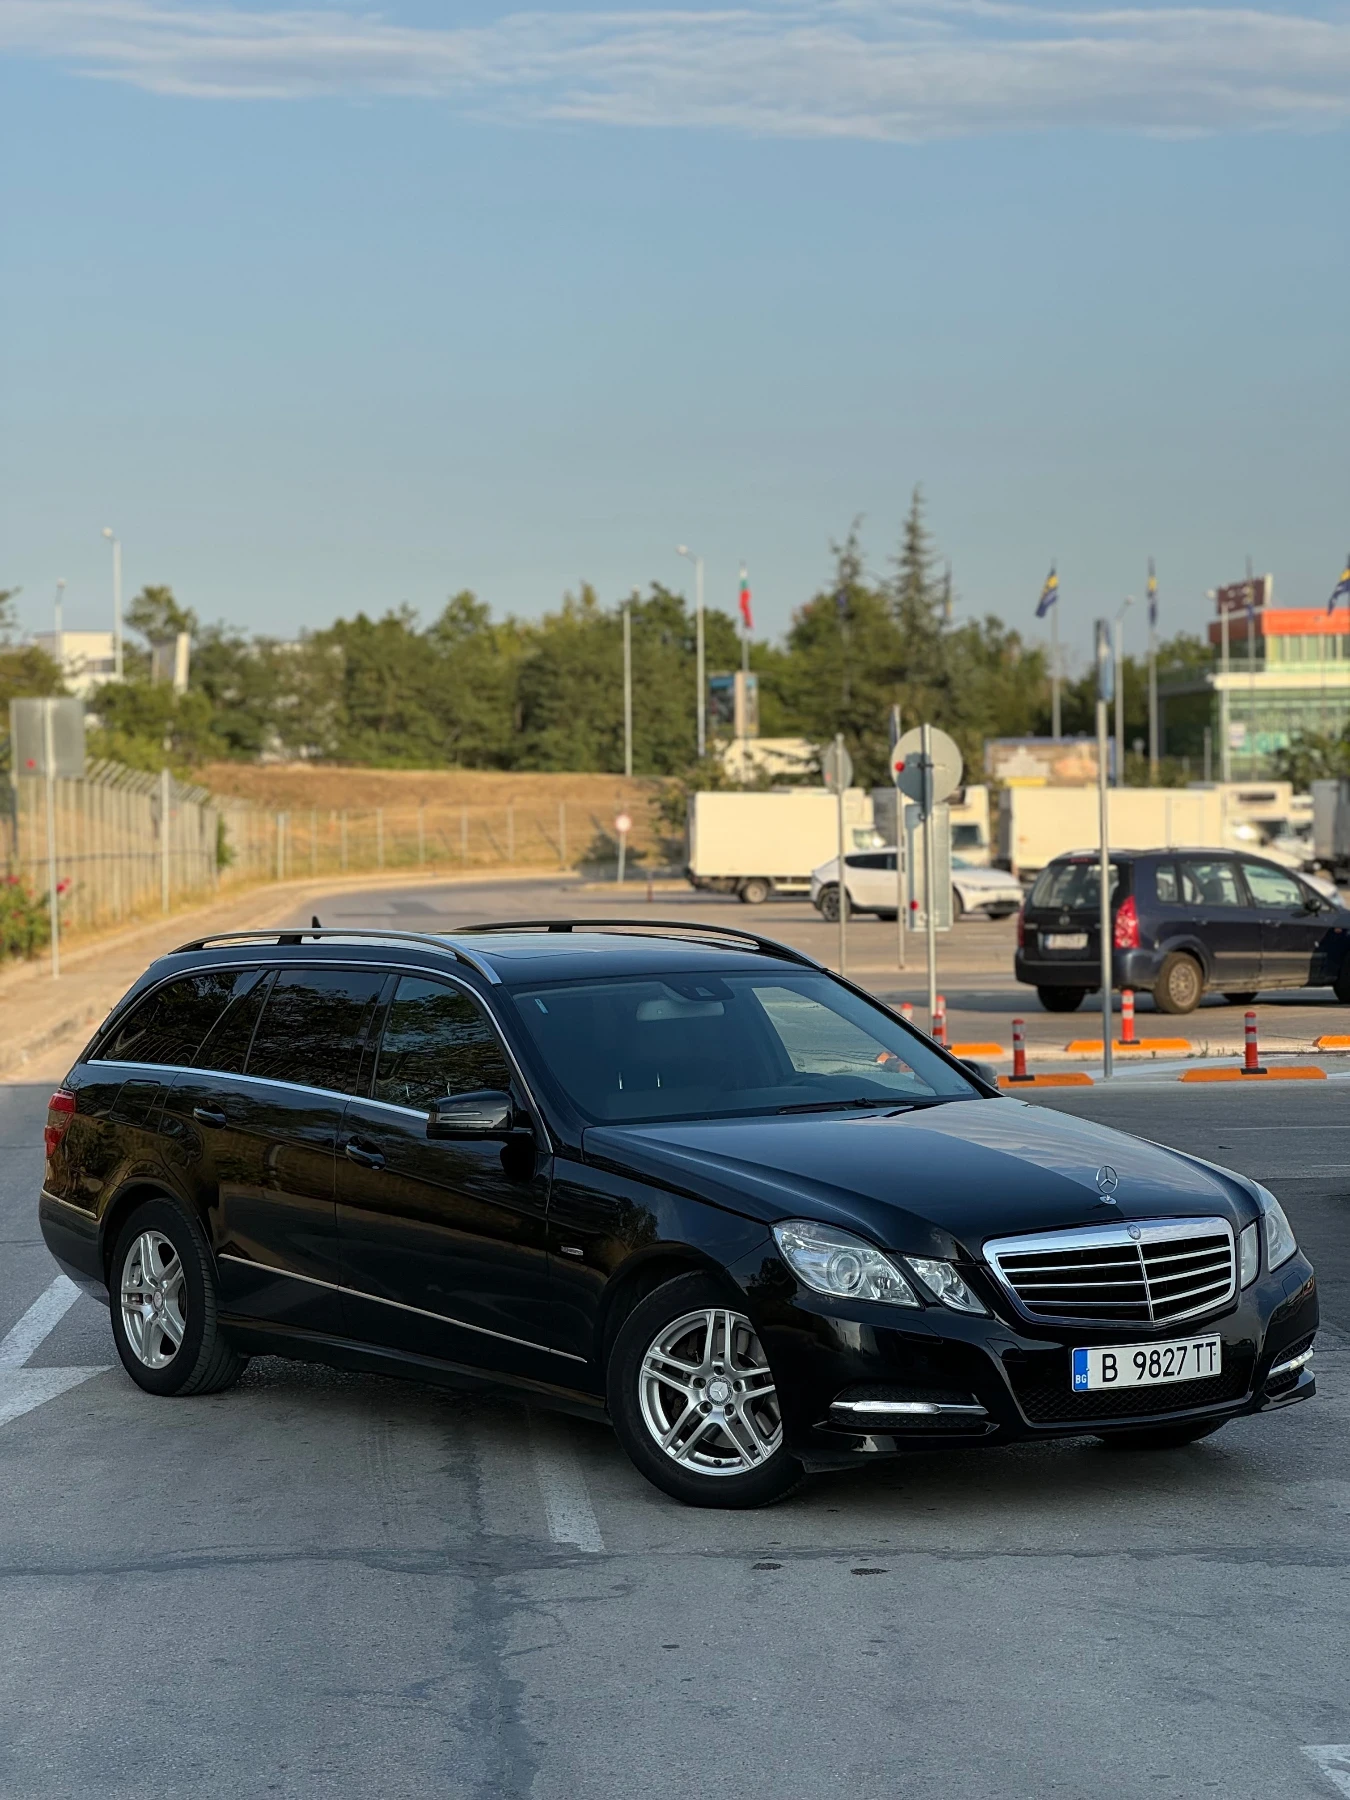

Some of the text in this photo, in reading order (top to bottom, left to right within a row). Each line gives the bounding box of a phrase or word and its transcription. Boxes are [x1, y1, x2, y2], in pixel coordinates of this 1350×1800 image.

[1102, 1354, 1118, 1382] B
[1133, 1346, 1187, 1380] 9827
[1075, 1374, 1087, 1384] BG
